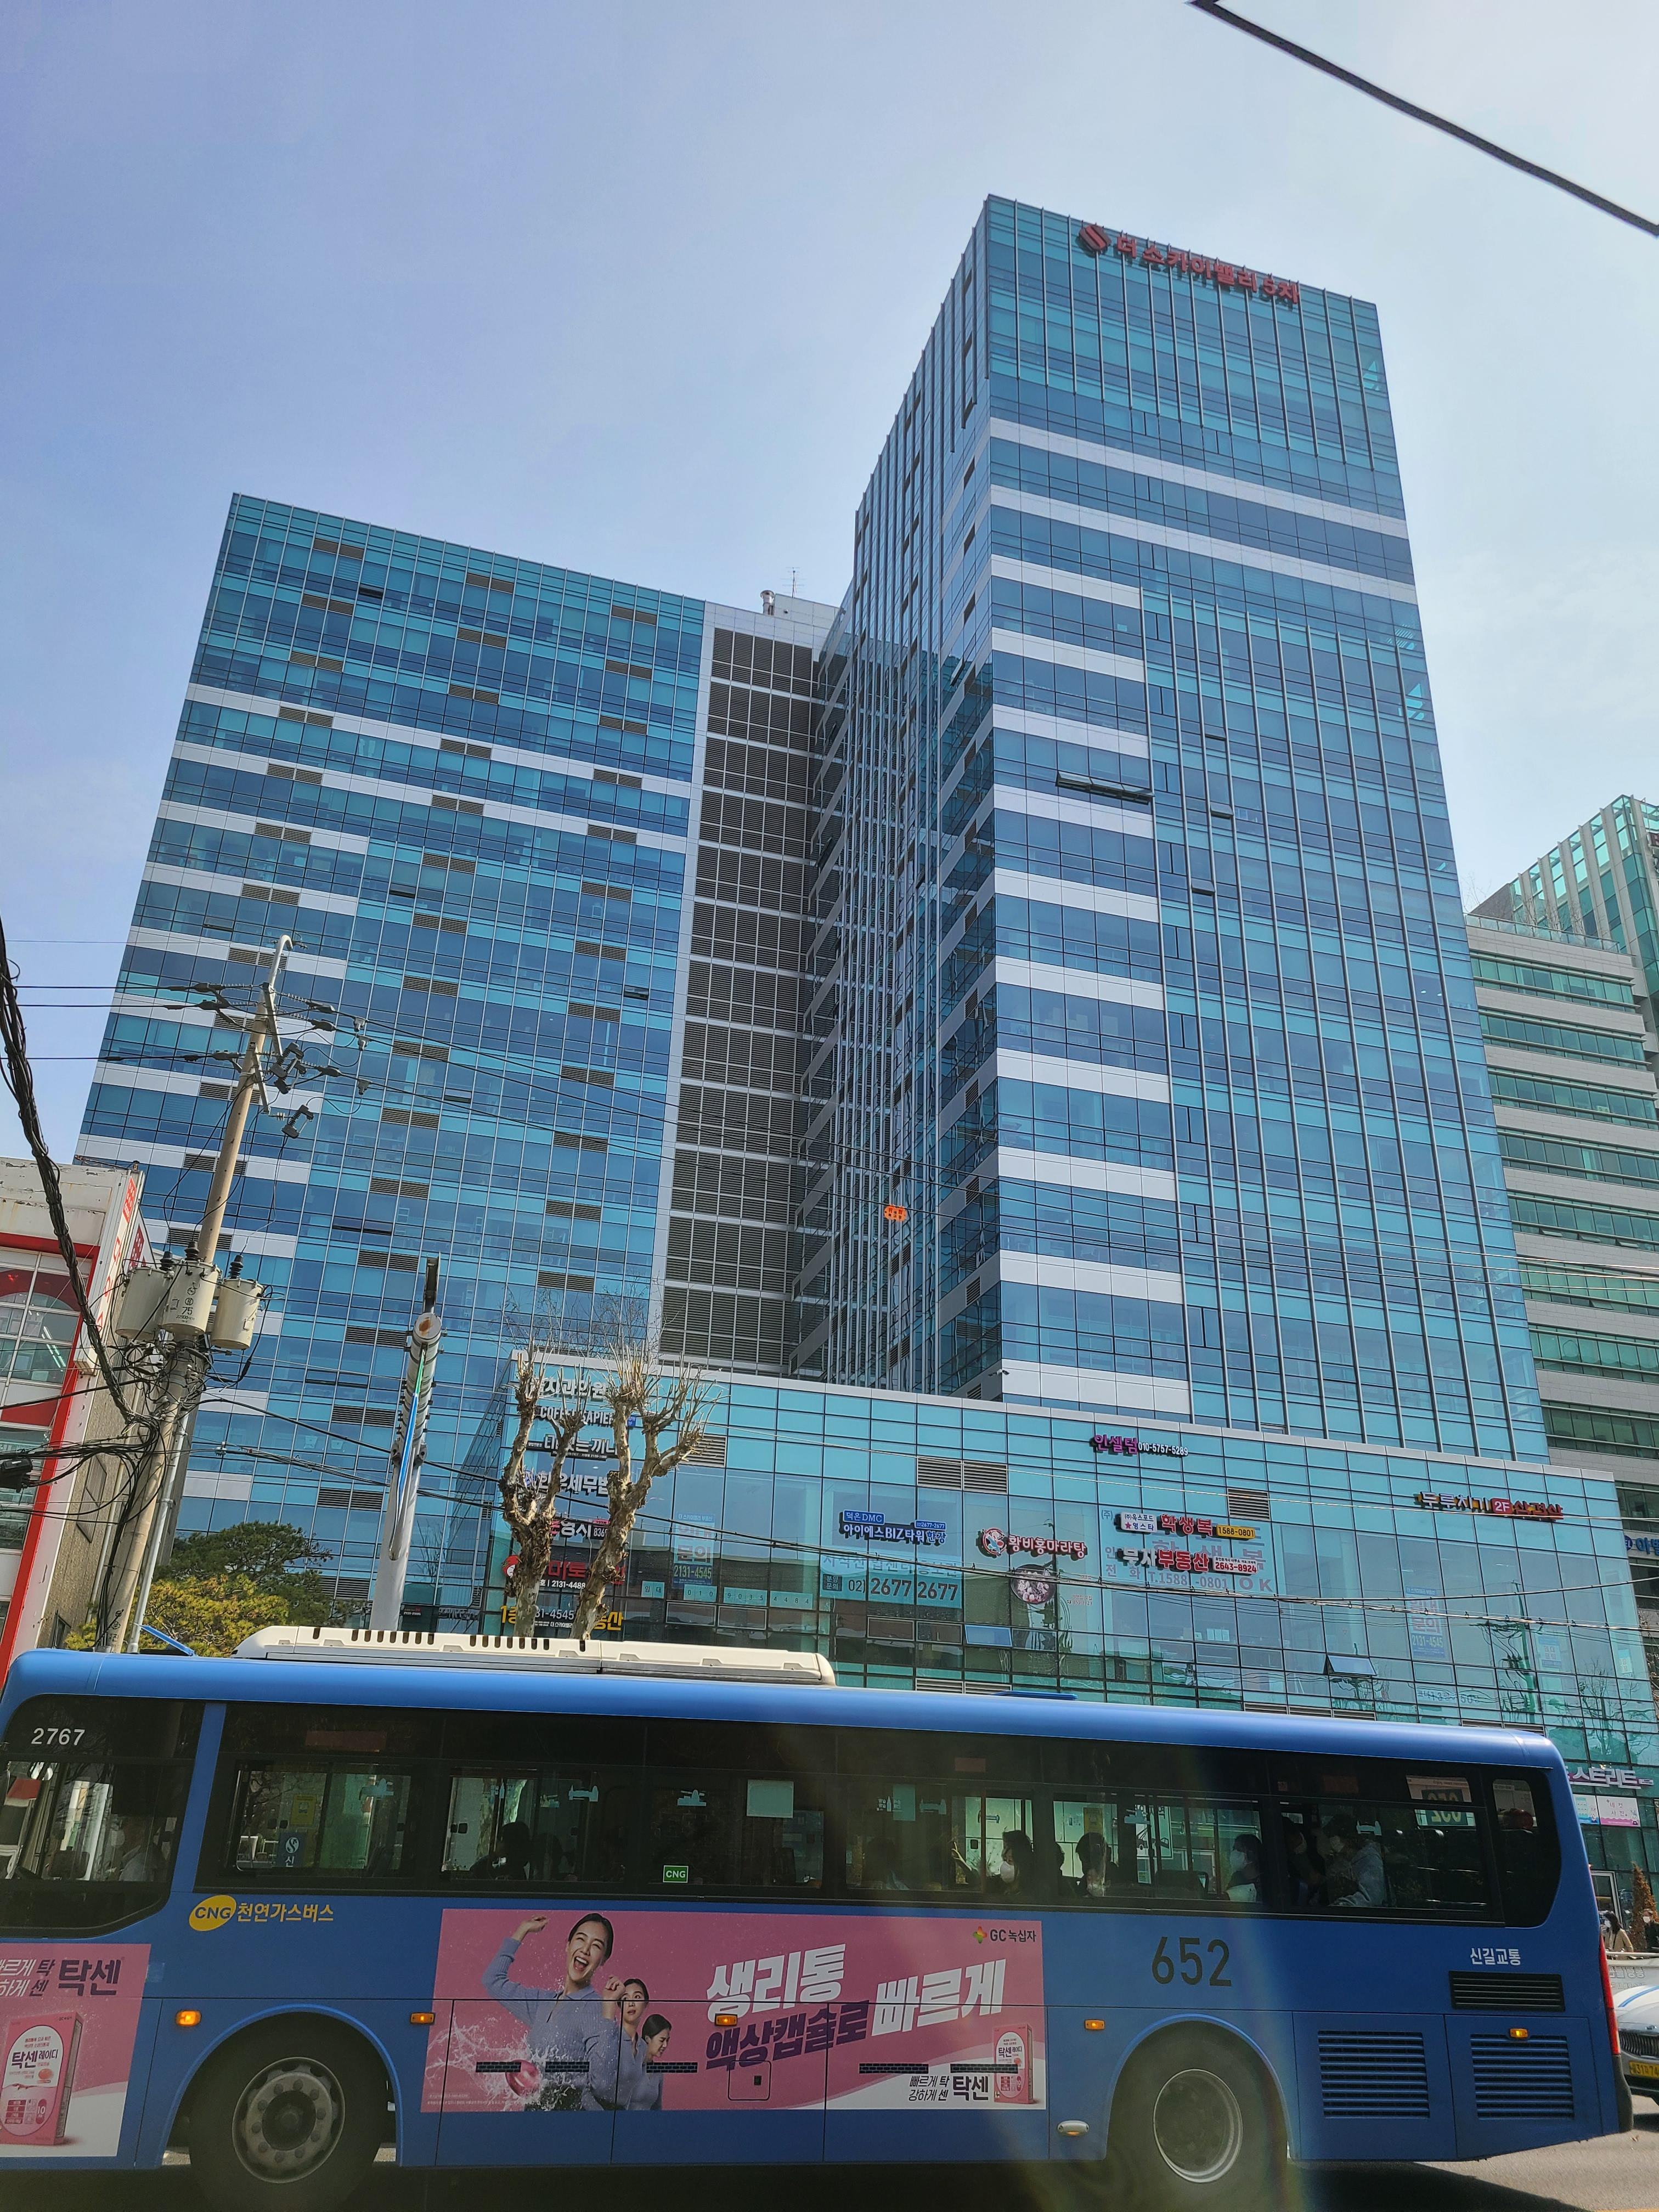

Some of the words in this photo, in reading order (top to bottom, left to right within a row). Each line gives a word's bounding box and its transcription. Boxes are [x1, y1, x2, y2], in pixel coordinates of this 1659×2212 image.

[1116, 235, 1137, 258] 더
[1142, 245, 1257, 293] 스카이밸리
[1262, 278, 1300, 304] 5차
[1094, 1435, 1138, 1454] 인셀덤
[1138, 1442, 1189, 1456] 010-5757-5289
[1421, 1491, 1489, 1511] 두루치기
[1494, 1501, 1509, 1512] 2F
[1160, 1514, 1212, 1536] 학생복
[1218, 1526, 1255, 1537] 1588-0801
[1008, 1534, 1086, 1559] 황비홍마라탕
[674, 1565, 712, 1579] 2131-4545
[1215, 1562, 1257, 1573] 2643-8924
[870, 1577, 912, 1597] 2677
[917, 1581, 958, 1601] 2677
[31, 1728, 86, 1746] 2767
[1564, 1765, 1641, 1790] 스트리트
[665, 1870, 686, 1880] CNG
[195, 1906, 231, 1919] CNG
[238, 1903, 334, 1922] 천연가스버스
[990, 1929, 1007, 1942] GC
[1008, 1929, 1036, 1942] 녹십자
[1152, 1936, 1232, 1987] 652
[1470, 1947, 1521, 1966] 신길교통
[36, 1960, 55, 1976] 탁
[58, 1959, 121, 1996] 탁센
[29, 1979, 49, 1997] 센
[707, 1943, 846, 2023] 생리통
[871, 1959, 1006, 2036] 빠르게
[706, 2000, 870, 2072] 액상캡슐로
[11, 2050, 38, 2069] 탁센
[38, 2049, 59, 2060] 레이디
[998, 2046, 1012, 2058] 탁센
[909, 2075, 939, 2087] 빠르게
[939, 2075, 950, 2087] 탁
[952, 2075, 989, 2101] 탁센
[908, 2089, 936, 2101] 강하게
[938, 2089, 949, 2101] 센
